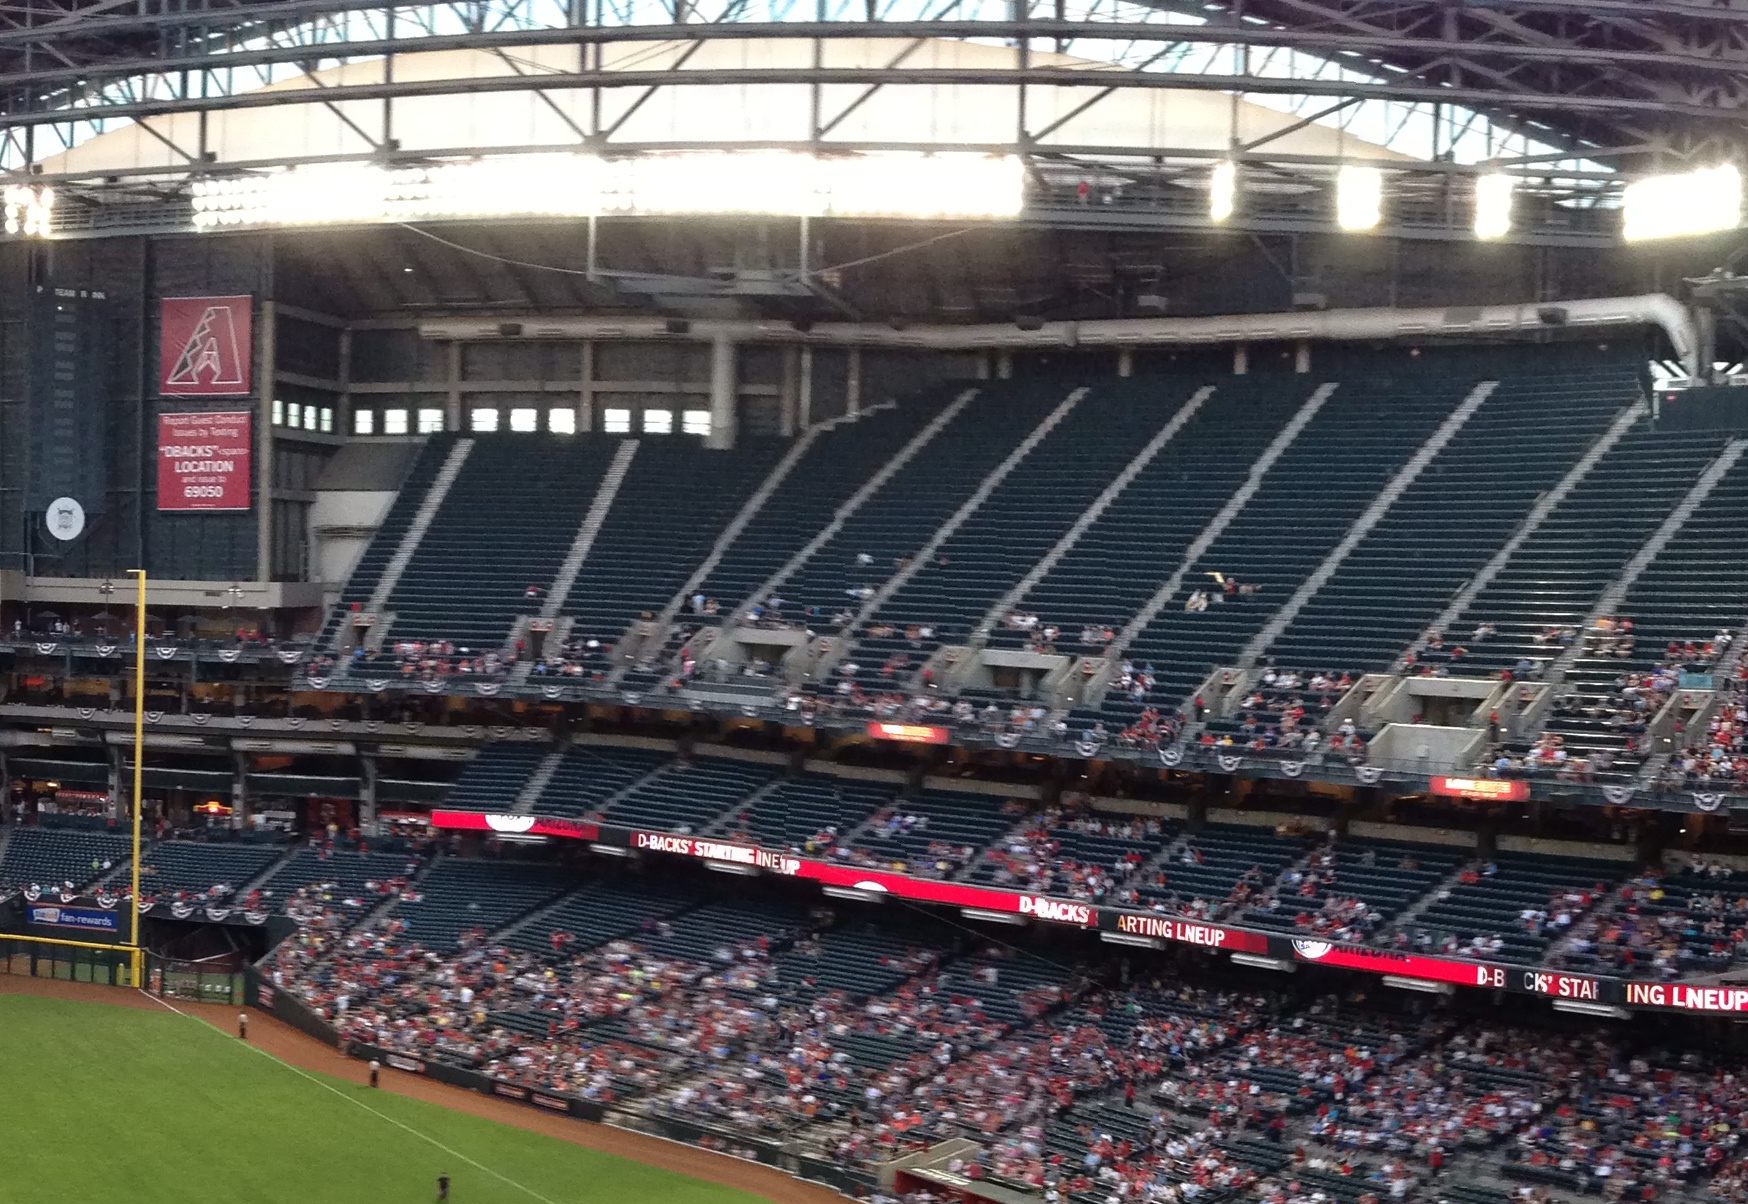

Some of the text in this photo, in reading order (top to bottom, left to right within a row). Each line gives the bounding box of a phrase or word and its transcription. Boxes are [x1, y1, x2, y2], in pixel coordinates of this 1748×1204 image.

[163, 416, 189, 426] Report
[190, 415, 213, 425] Guest
[174, 461, 234, 473] LOCATION
[184, 486, 224, 498] 69050
[60, 911, 113, 927] fan-rewards
